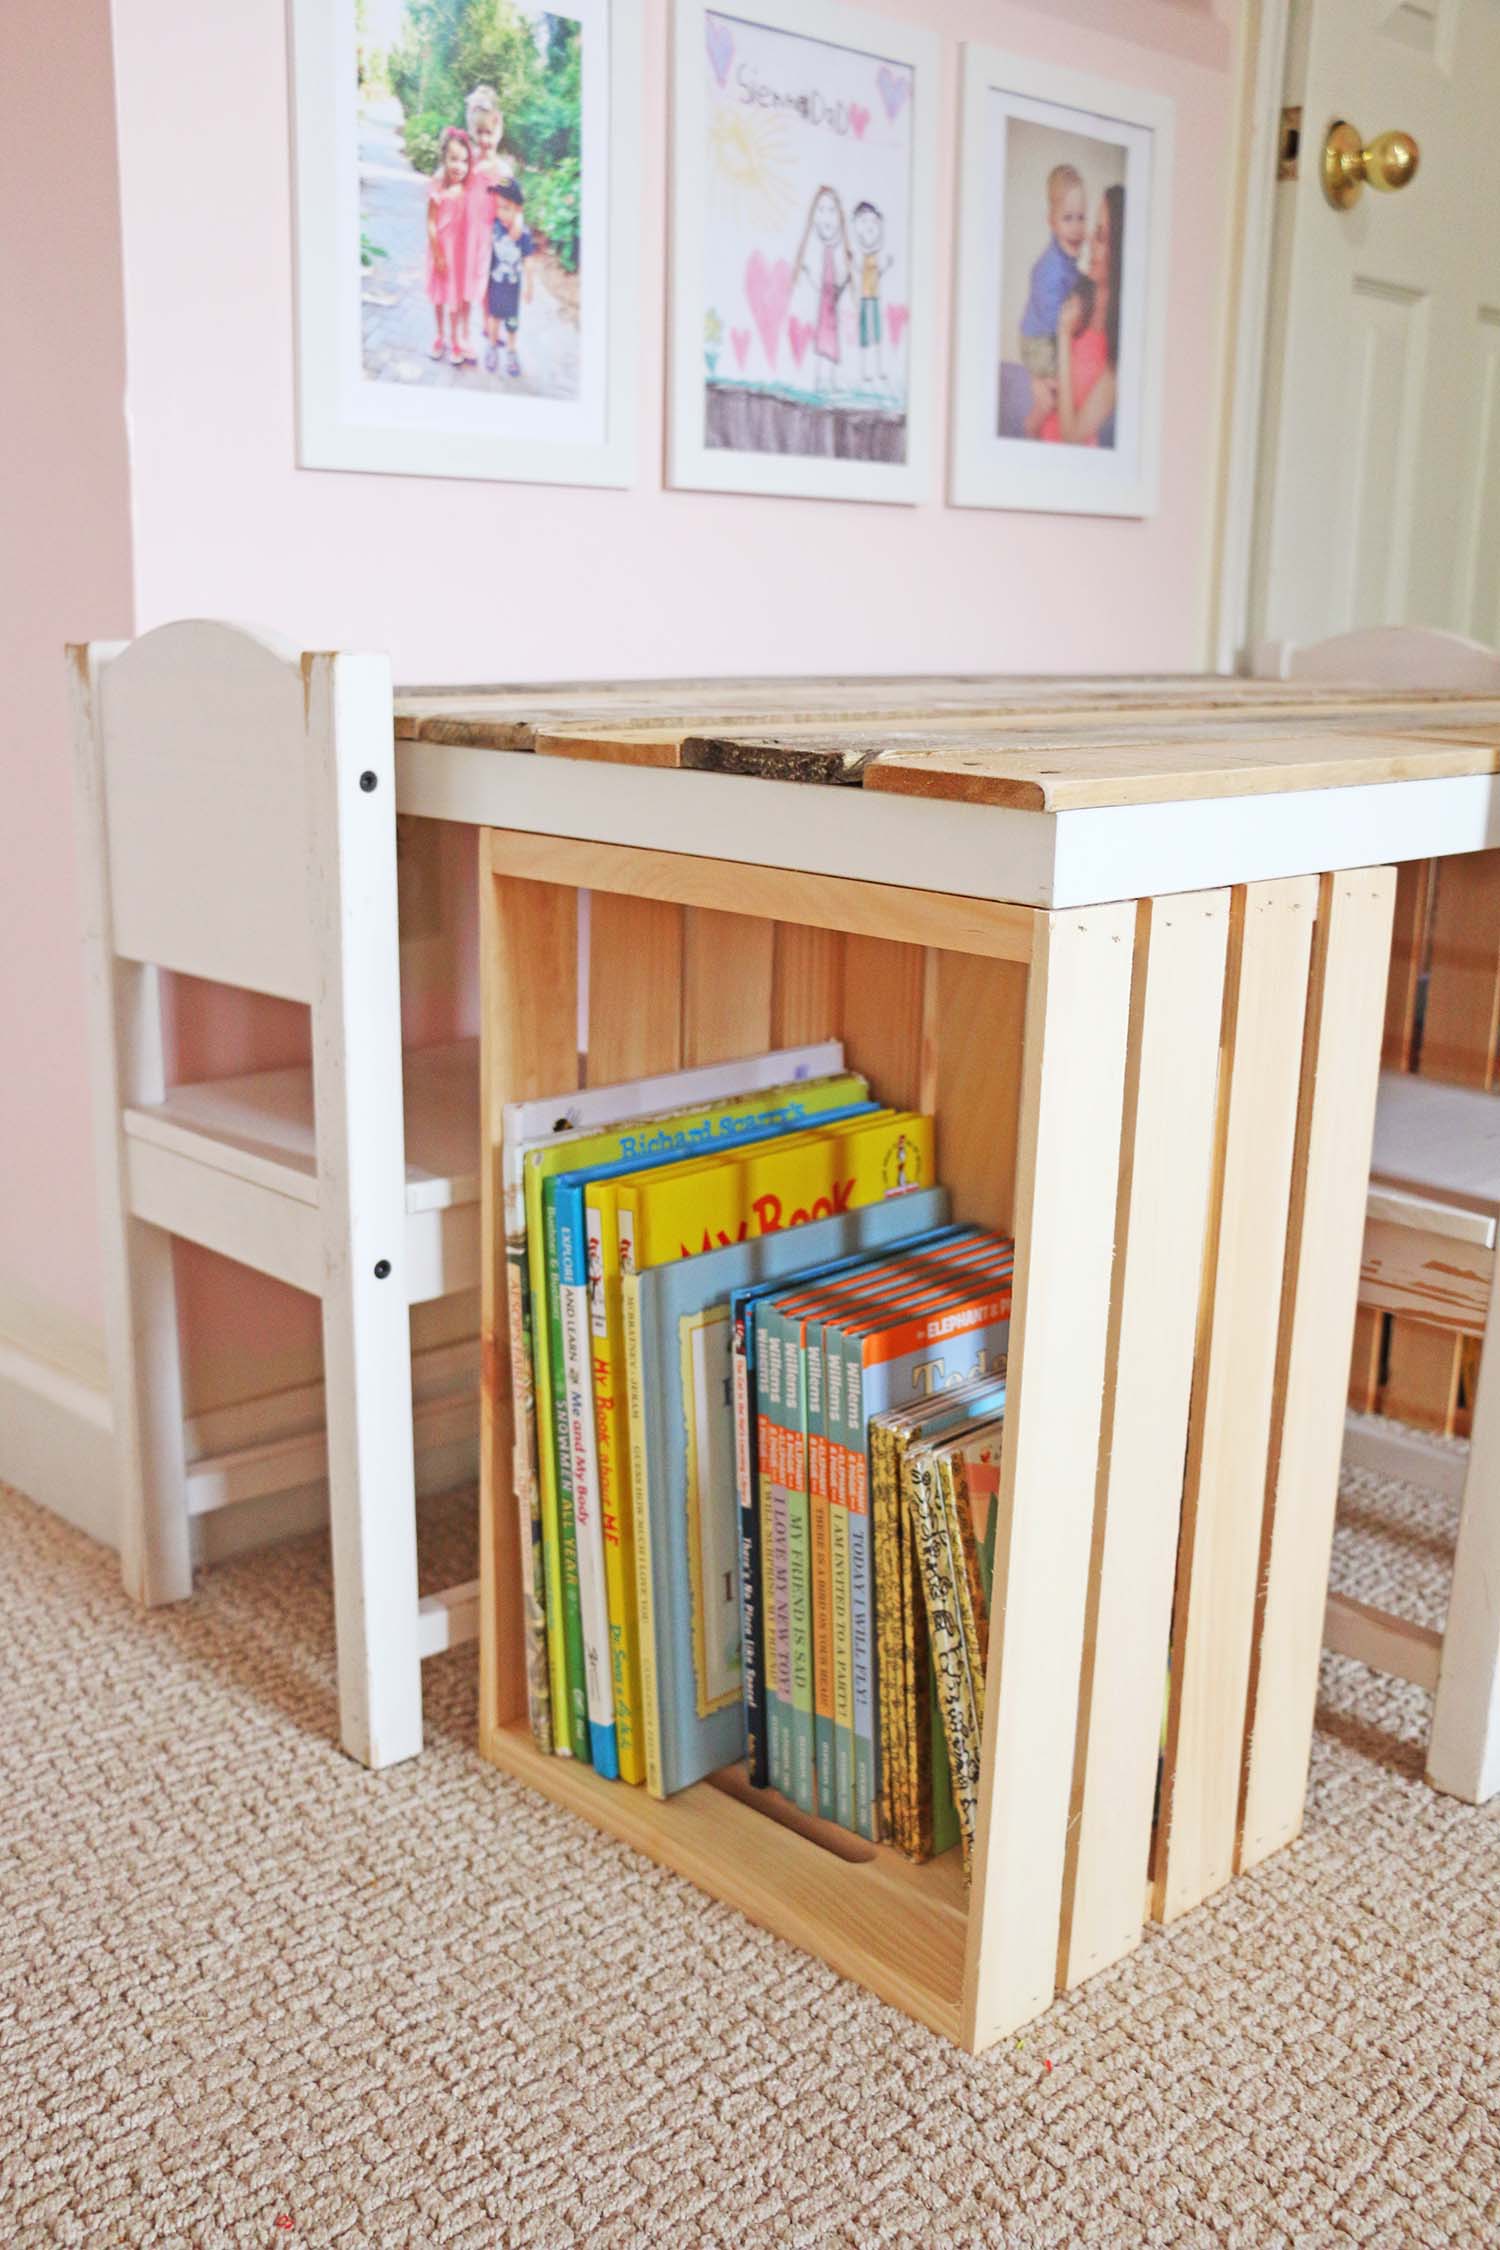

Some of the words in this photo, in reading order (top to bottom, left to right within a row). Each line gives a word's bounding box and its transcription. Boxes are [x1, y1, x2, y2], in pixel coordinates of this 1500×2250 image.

[619, 1117, 712, 1160] Richard
[560, 1227, 575, 1283] EXPLORE
[566, 1287, 577, 1318] AND
[566, 1320, 579, 1362] LEARN
[769, 1337, 782, 1403] Willems
[785, 1342, 798, 1408] Willems
[807, 1346, 822, 1413] Willems
[828, 1354, 842, 1421] Willems
[571, 1392, 583, 1417] Me
[846, 1362, 861, 1429] Willems
[573, 1420, 586, 1453] and
[571, 1456, 588, 1482] My
[562, 1498, 576, 1529] ALL
[576, 1485, 591, 1526] Body
[600, 1511, 621, 1548] ME
[775, 1509, 787, 1561] LOVE
[788, 1513, 803, 1543] MY
[833, 1525, 845, 1550] AM
[562, 1537, 579, 1585] YEAR
[776, 1568, 788, 1595] MY
[852, 1530, 866, 1595] TODAY
[791, 1549, 805, 1622] FRIEND
[834, 1552, 847, 1617] INVITED
[777, 1602, 790, 1641] NEW
[793, 1627, 806, 1646] IS
[836, 1623, 847, 1642] TO
[854, 1611, 867, 1659] WILL
[778, 1652, 792, 1696] TOY!
[793, 1651, 807, 1689] SAD
[837, 1660, 849, 1718] PARTY!
[855, 1663, 868, 1706] FLY!
